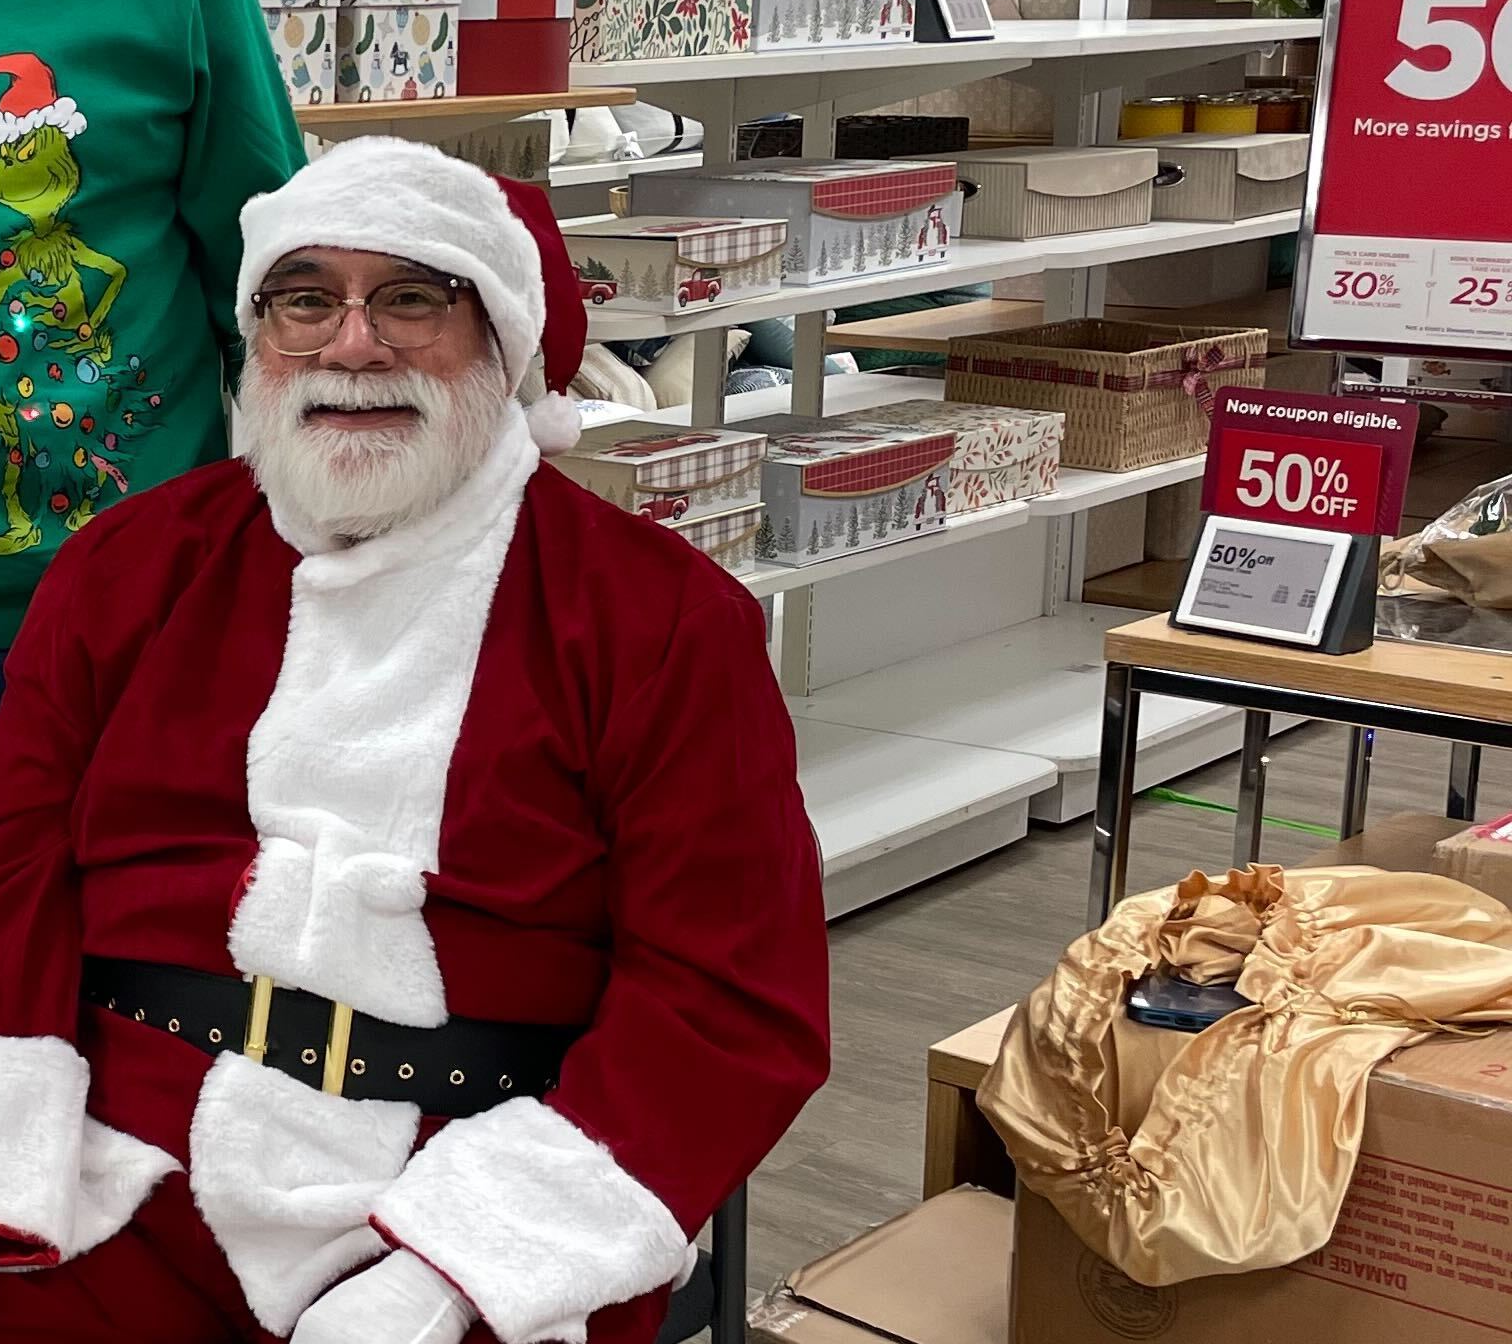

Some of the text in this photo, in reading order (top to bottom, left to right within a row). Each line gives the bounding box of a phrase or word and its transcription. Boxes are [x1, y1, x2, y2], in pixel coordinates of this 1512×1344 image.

[1353, 117, 1409, 137] More
[1414, 119, 1501, 142] savings
[1326, 271, 1394, 300] 30%
[1377, 287, 1400, 296] OFF
[1225, 399, 1402, 430] Now coupon eligible.
[1236, 448, 1349, 513] 50%
[1311, 494, 1358, 518] OFF
[1209, 544, 1257, 569] 50%
[1257, 555, 1275, 566] Off
[1329, 1253, 1407, 1291] DAMAGE
